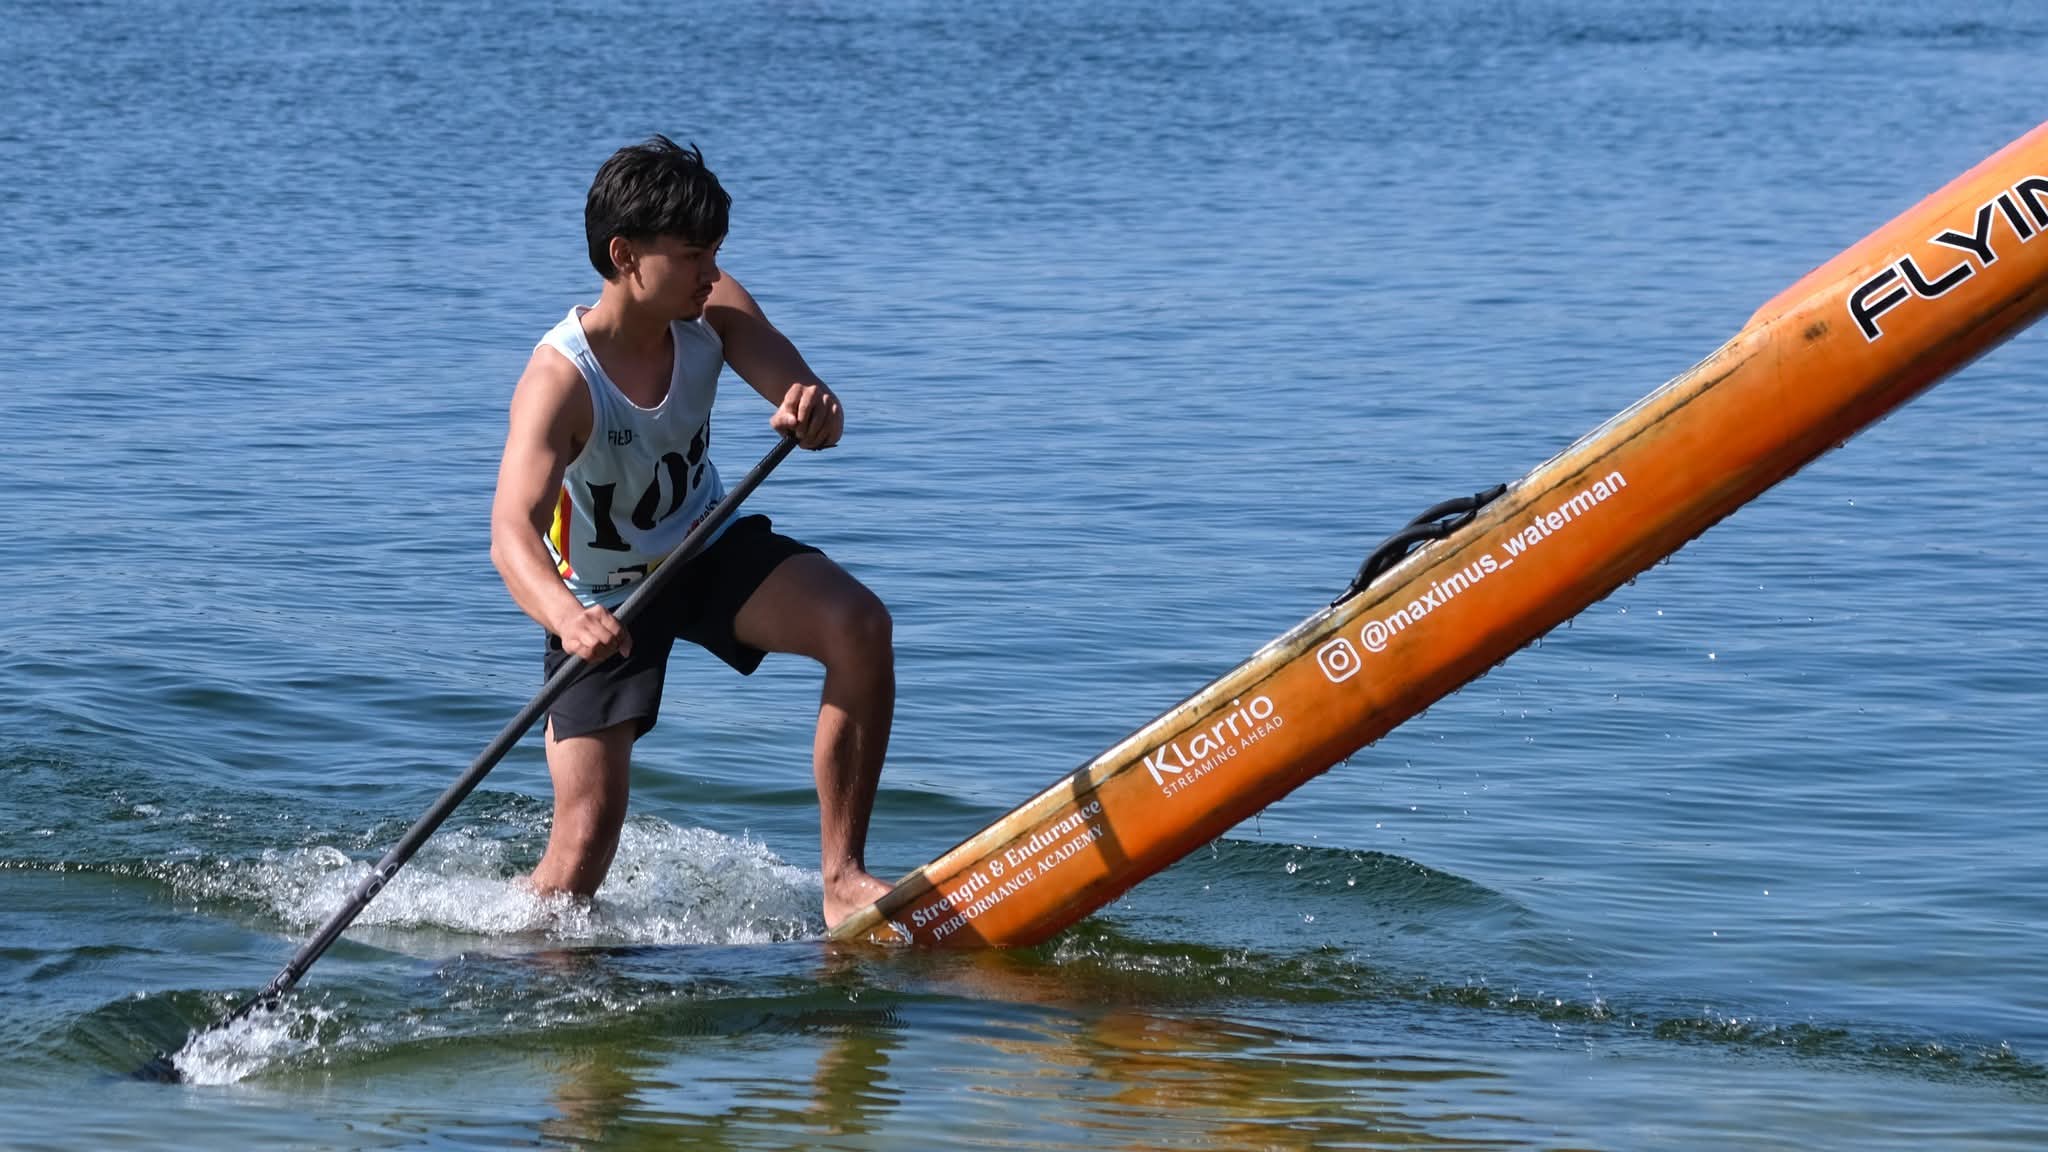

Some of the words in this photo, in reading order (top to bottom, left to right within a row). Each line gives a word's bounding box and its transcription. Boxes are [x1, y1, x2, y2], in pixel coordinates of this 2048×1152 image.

[1361, 471, 1627, 653] @maximus_waterman
[1143, 696, 1274, 786] Klarrio
[1162, 745, 1238, 798] STREAMING
[1240, 716, 1284, 750] AHEAD
[911, 870, 990, 928] Strength
[989, 859, 1005, 878] &
[1004, 800, 1102, 868] Endurance
[932, 869, 1037, 941] PERFORMANCE
[1038, 823, 1104, 876] ACADEMY
